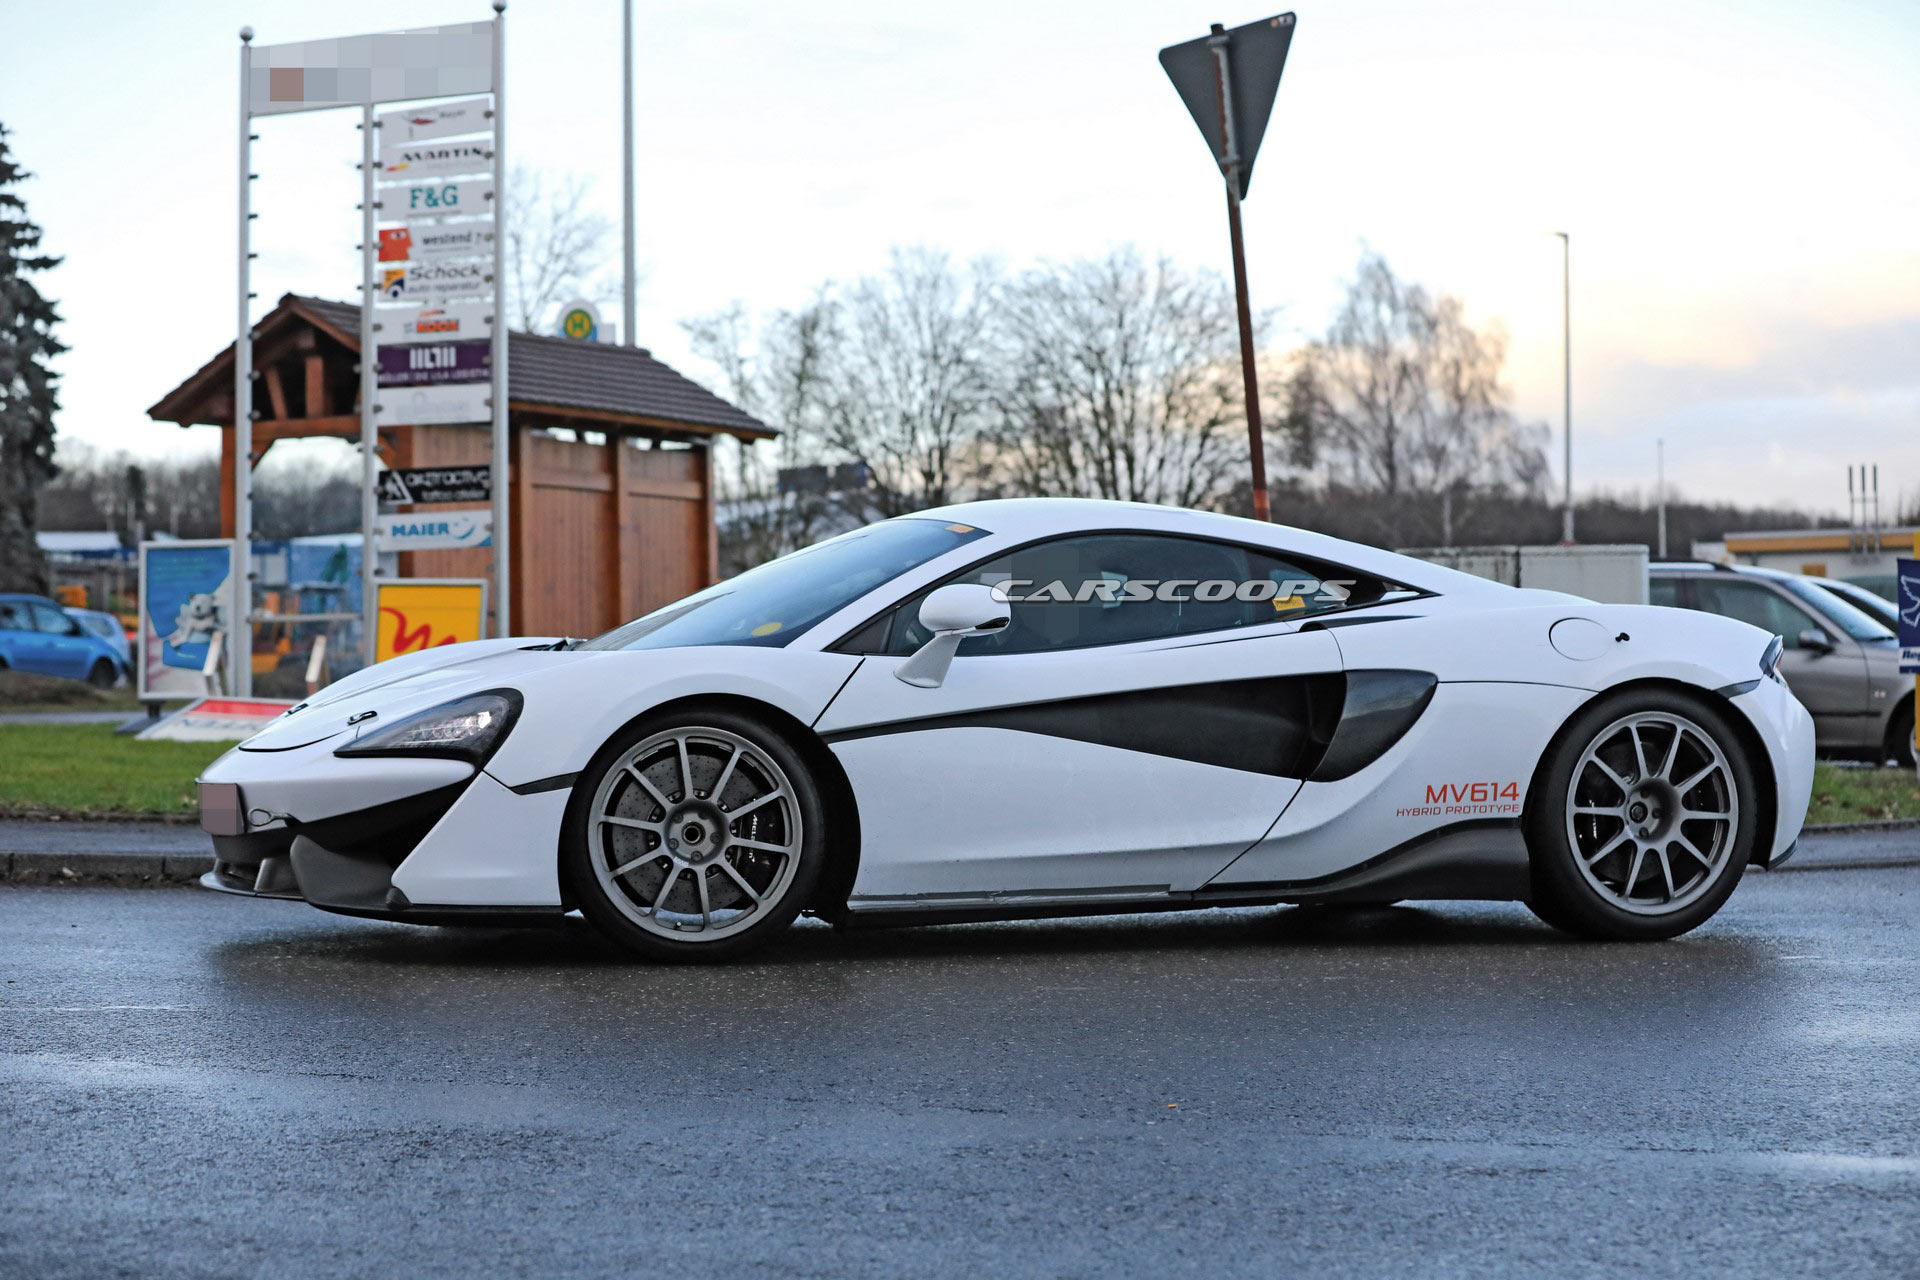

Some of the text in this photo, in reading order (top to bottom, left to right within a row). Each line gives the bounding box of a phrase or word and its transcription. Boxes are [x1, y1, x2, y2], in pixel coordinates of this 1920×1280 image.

[410, 185, 458, 208] F&G
[409, 264, 479, 281] Schock
[392, 522, 449, 537] MAIER
[1425, 781, 1519, 804] MV614
[1396, 803, 1520, 817] HYBRID PROTOTYPE
